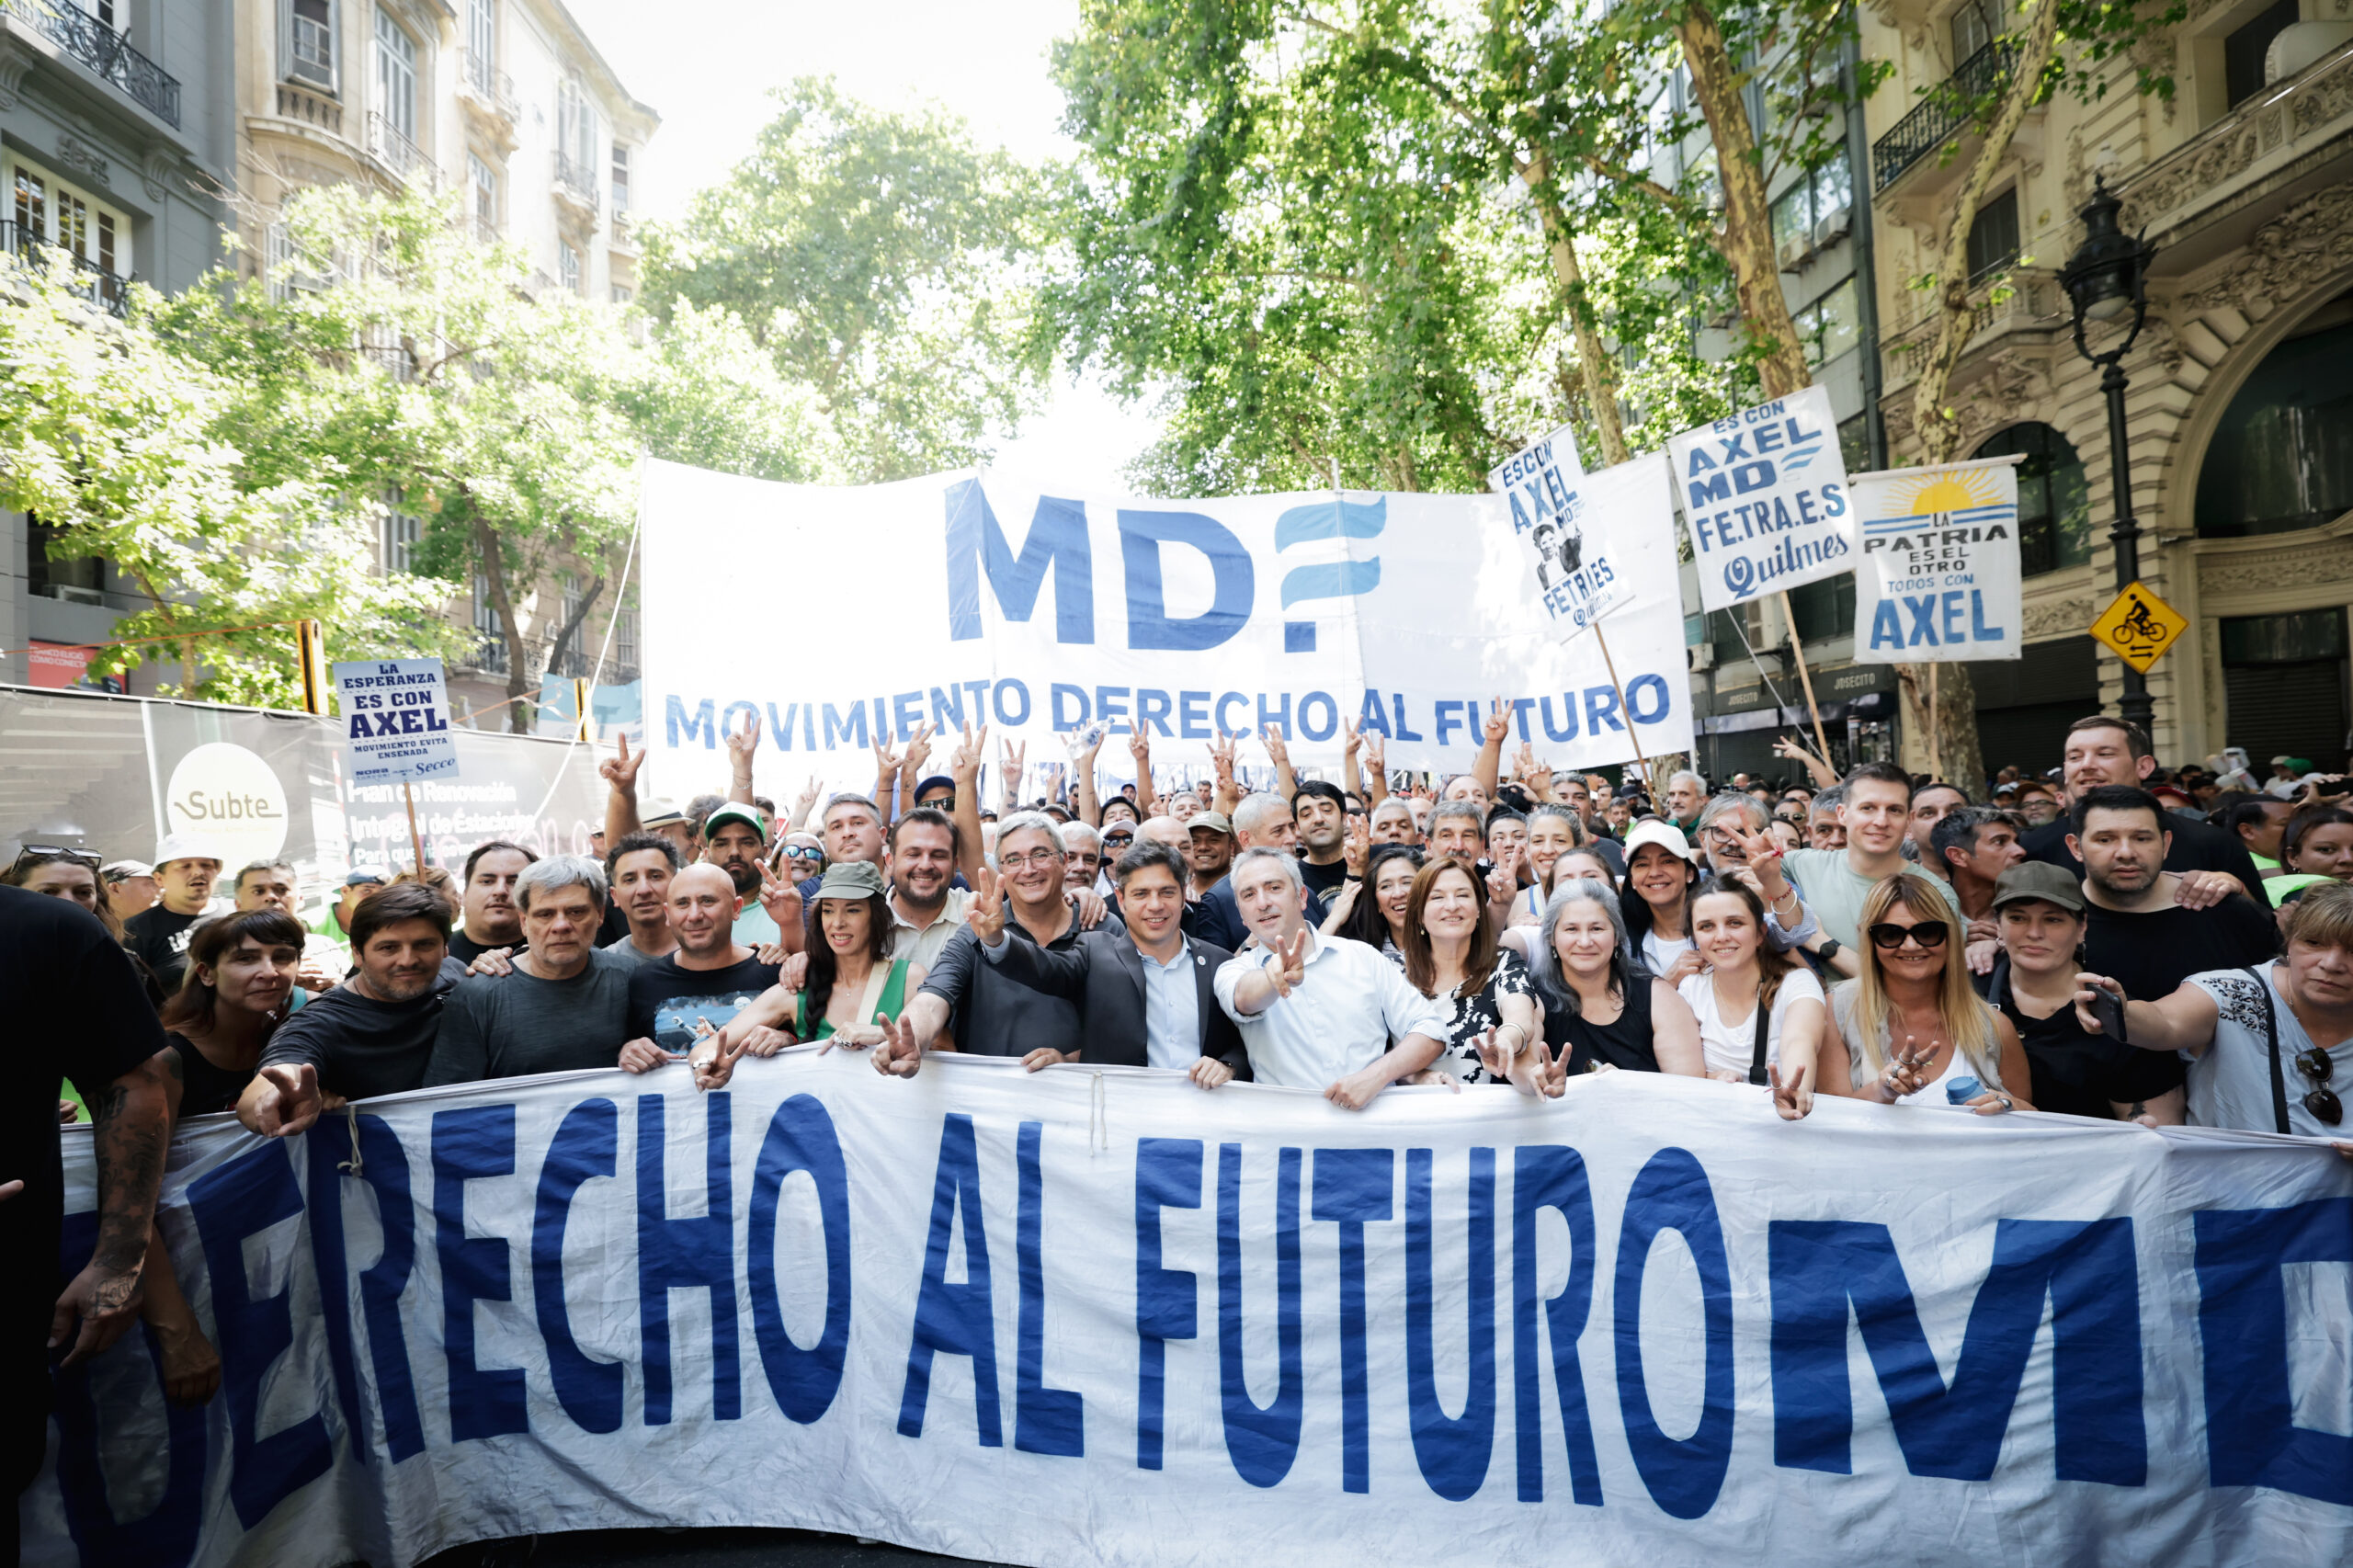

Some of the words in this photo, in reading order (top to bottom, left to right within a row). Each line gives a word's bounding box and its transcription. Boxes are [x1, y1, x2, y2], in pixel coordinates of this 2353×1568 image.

[1713, 415, 1740, 434] ES
[1745, 400, 1785, 424] CON
[1688, 417, 1823, 478] AXEL
[1509, 465, 1578, 535] AXEL
[1934, 512, 1949, 528] LA
[1864, 525, 2008, 553] PATRIA
[1723, 532, 1848, 600] Quilmes
[1910, 560, 1965, 575] OTRO
[1888, 577, 1934, 593] TODOS
[1945, 574, 1974, 586] CON
[1870, 588, 2004, 650] AXEL
[344, 673, 437, 688] ESPERANZA
[379, 664, 399, 675] LA
[354, 695, 382, 710] ES
[391, 690, 432, 706] CON
[665, 677, 1031, 752] MOVIMIENTO
[1051, 682, 1338, 742] DERECHO
[1361, 687, 1423, 742] AL
[1436, 673, 1671, 749] FUTURO
[350, 708, 448, 739] AXEL
[354, 741, 416, 753] MOVIMIENTO
[420, 738, 448, 747] EVITA
[378, 748, 428, 759] ENSENADA
[415, 758, 455, 776] Secco
[174, 790, 282, 820] Subte
[896, 1112, 1084, 1458] AL
[1136, 1137, 1733, 1520] FUTURO
